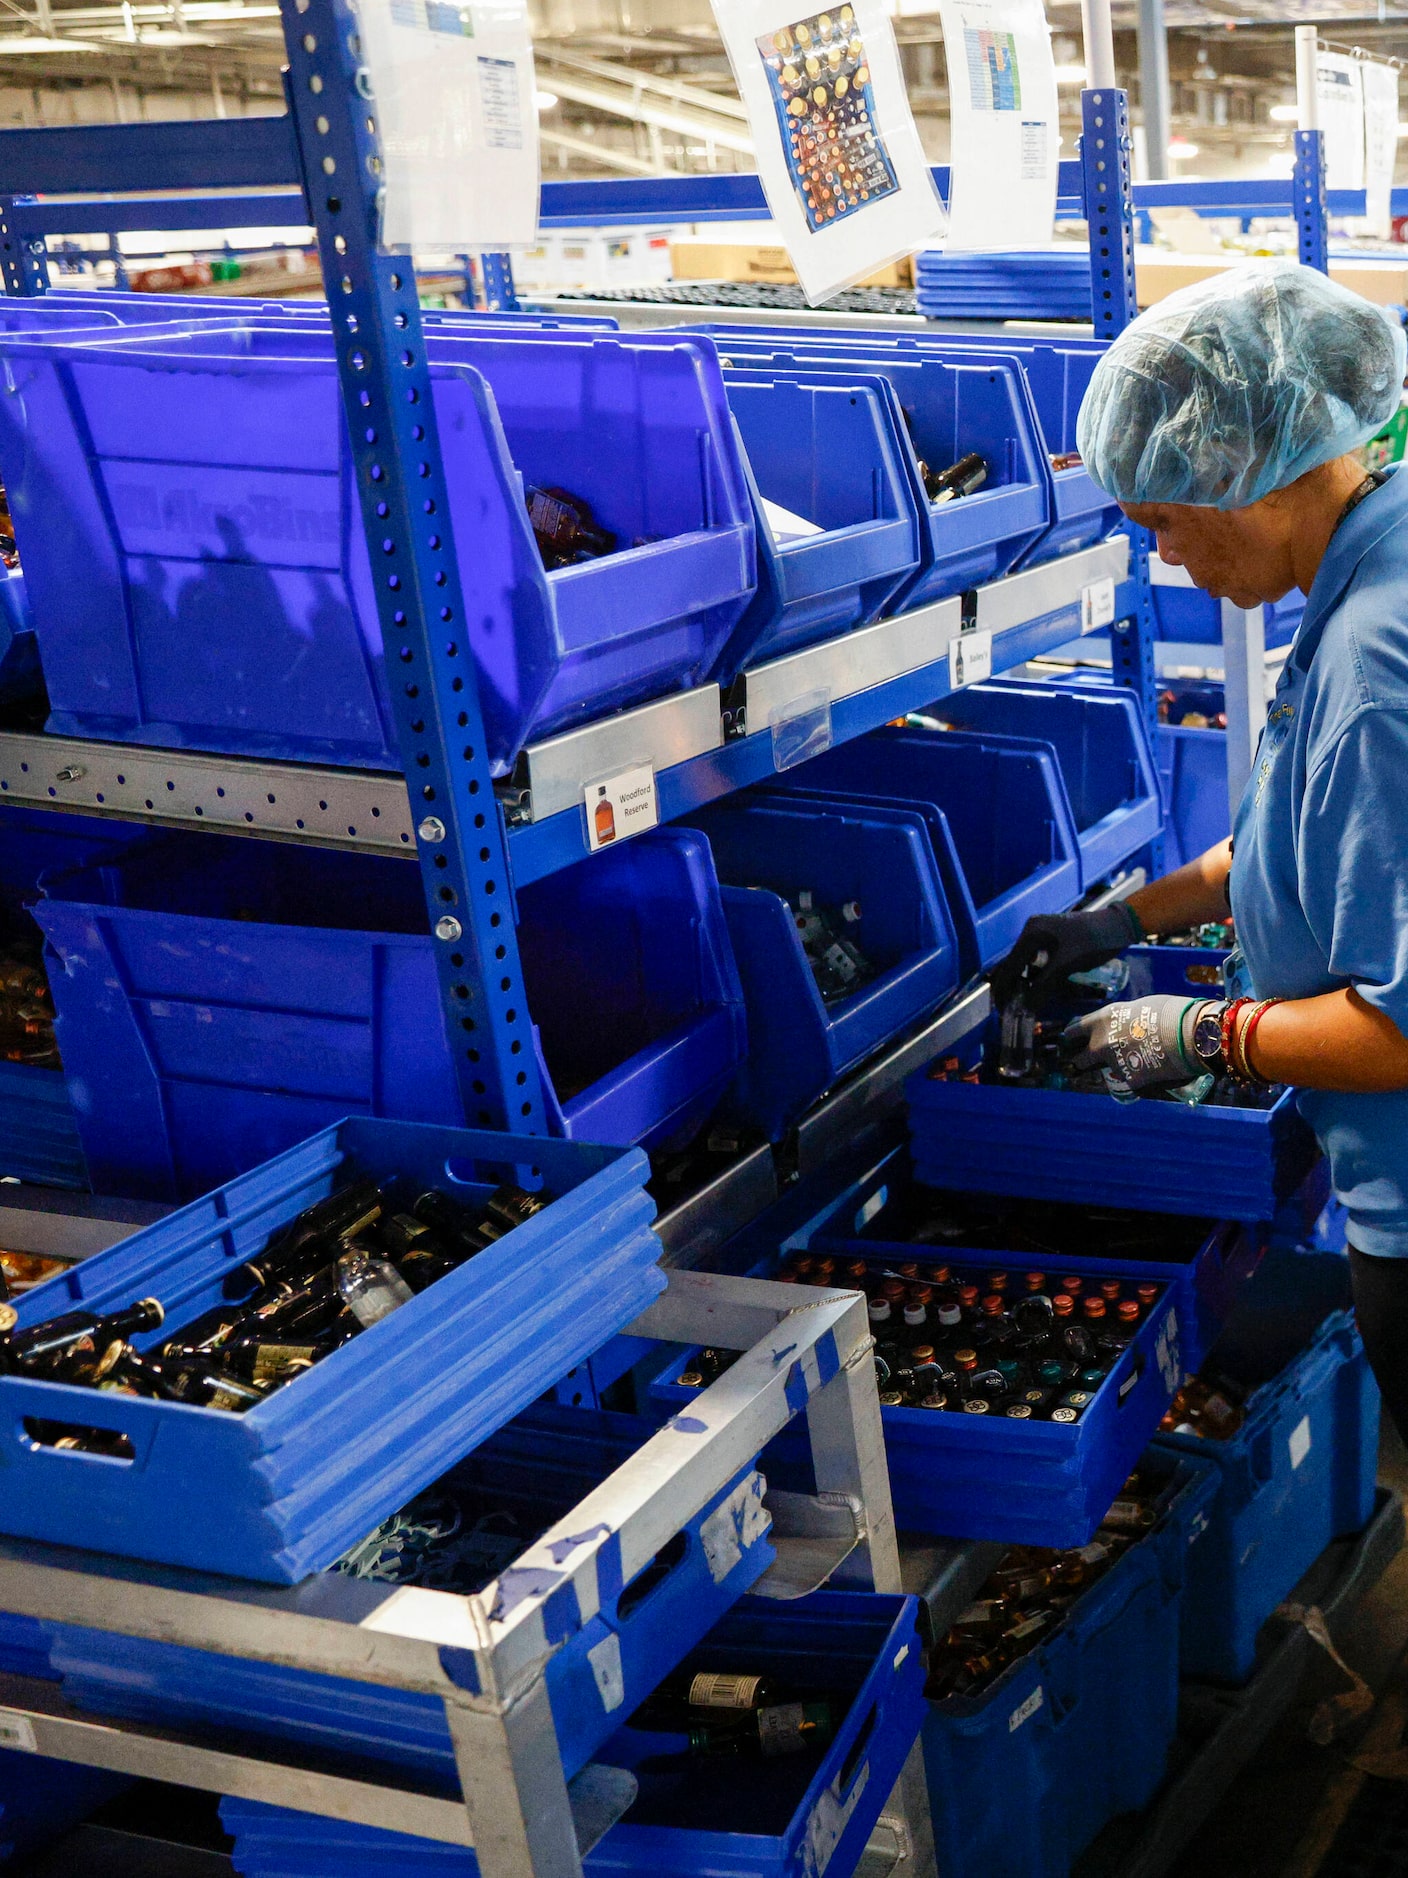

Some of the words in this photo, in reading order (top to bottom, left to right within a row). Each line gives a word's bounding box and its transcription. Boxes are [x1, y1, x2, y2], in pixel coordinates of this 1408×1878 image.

[619, 784, 651, 803] Woodford
[624, 801, 649, 817] Reserve
[1108, 1008, 1132, 1080] MaxiFlex
